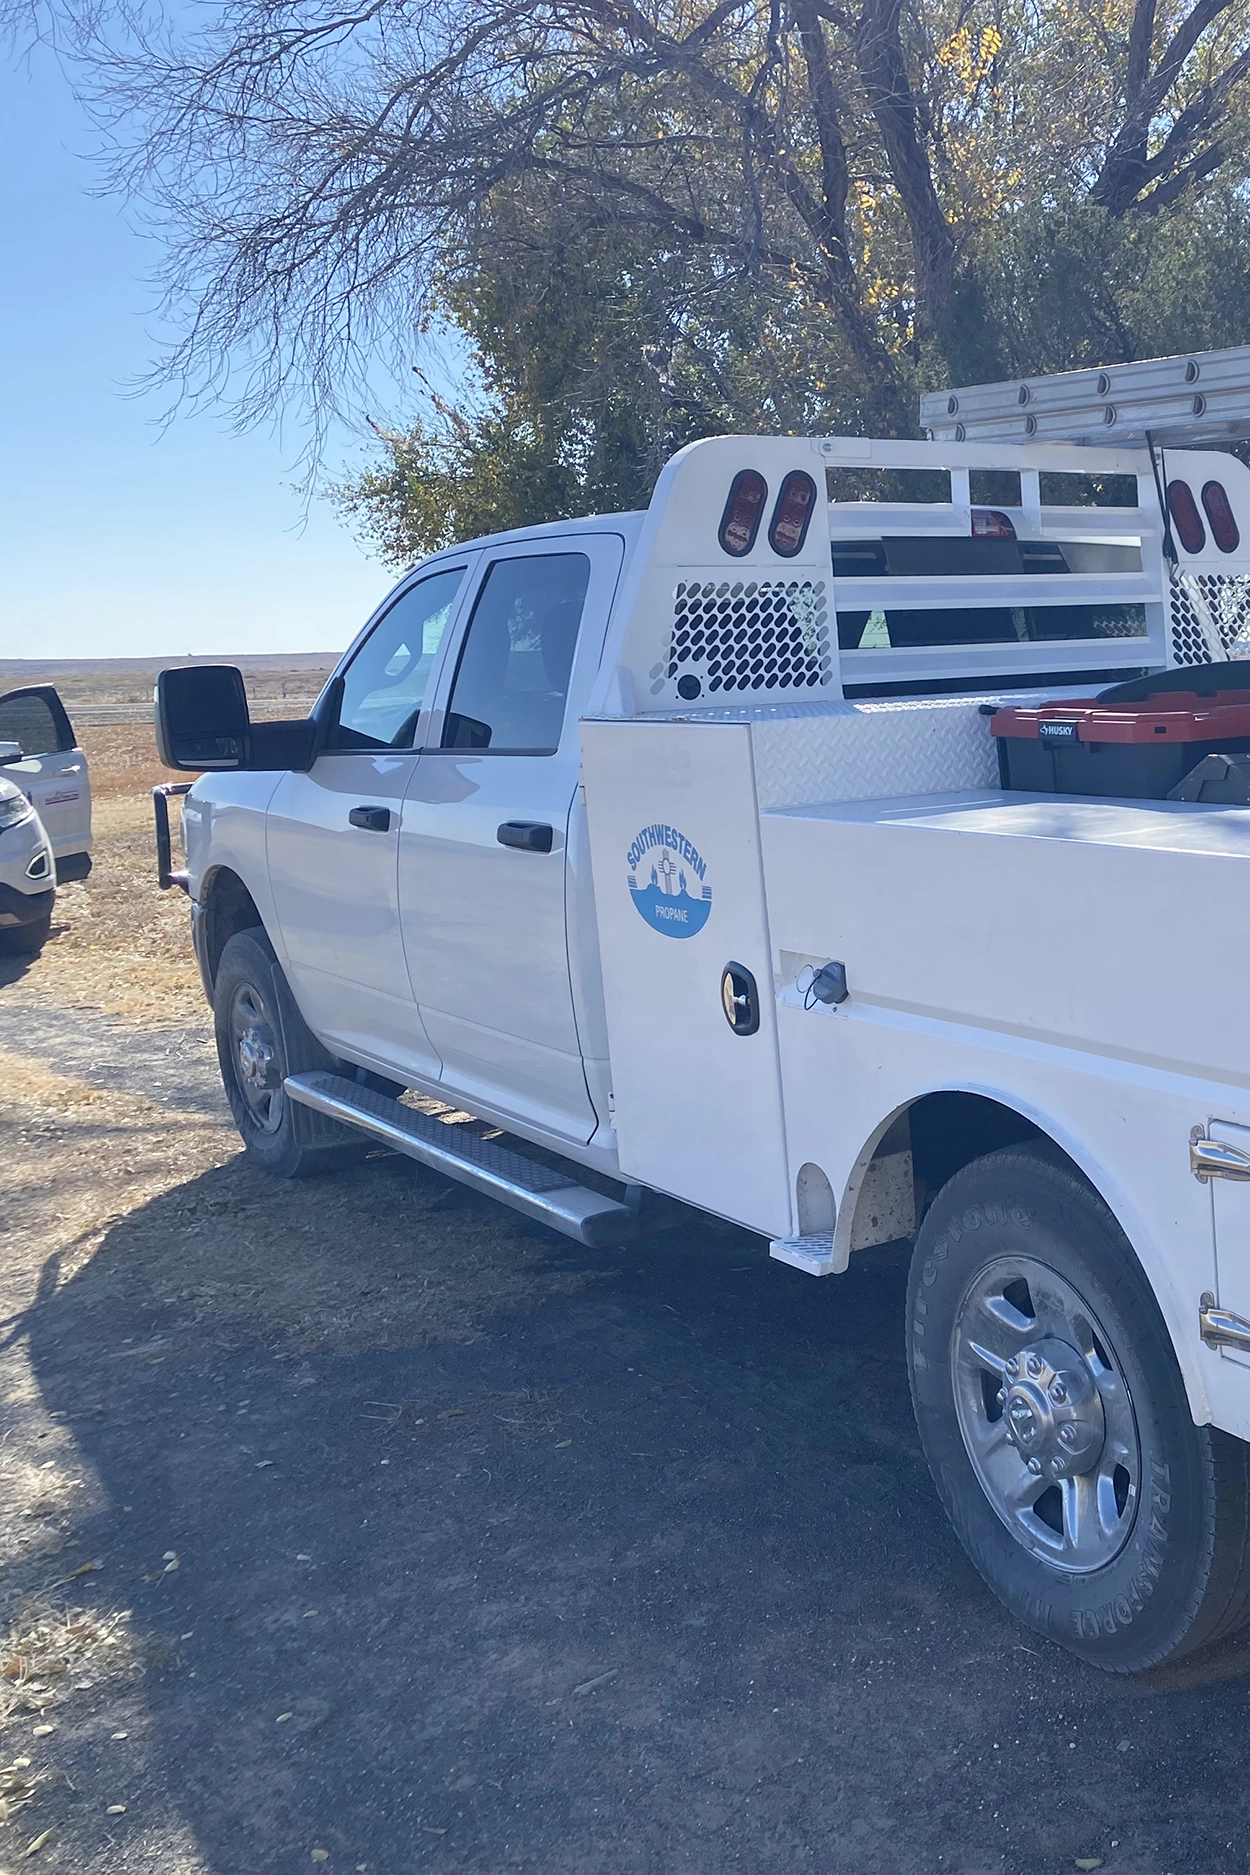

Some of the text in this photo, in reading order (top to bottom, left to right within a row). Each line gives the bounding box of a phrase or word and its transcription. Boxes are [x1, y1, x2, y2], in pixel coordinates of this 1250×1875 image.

[1048, 725, 1073, 736] HUSKY
[627, 824, 707, 881] SOUTHWESTERN
[655, 904, 689, 923] PROPANE
[913, 1203, 1034, 1373] Firestone
[1071, 1458, 1172, 1640] TRANSFORCE
